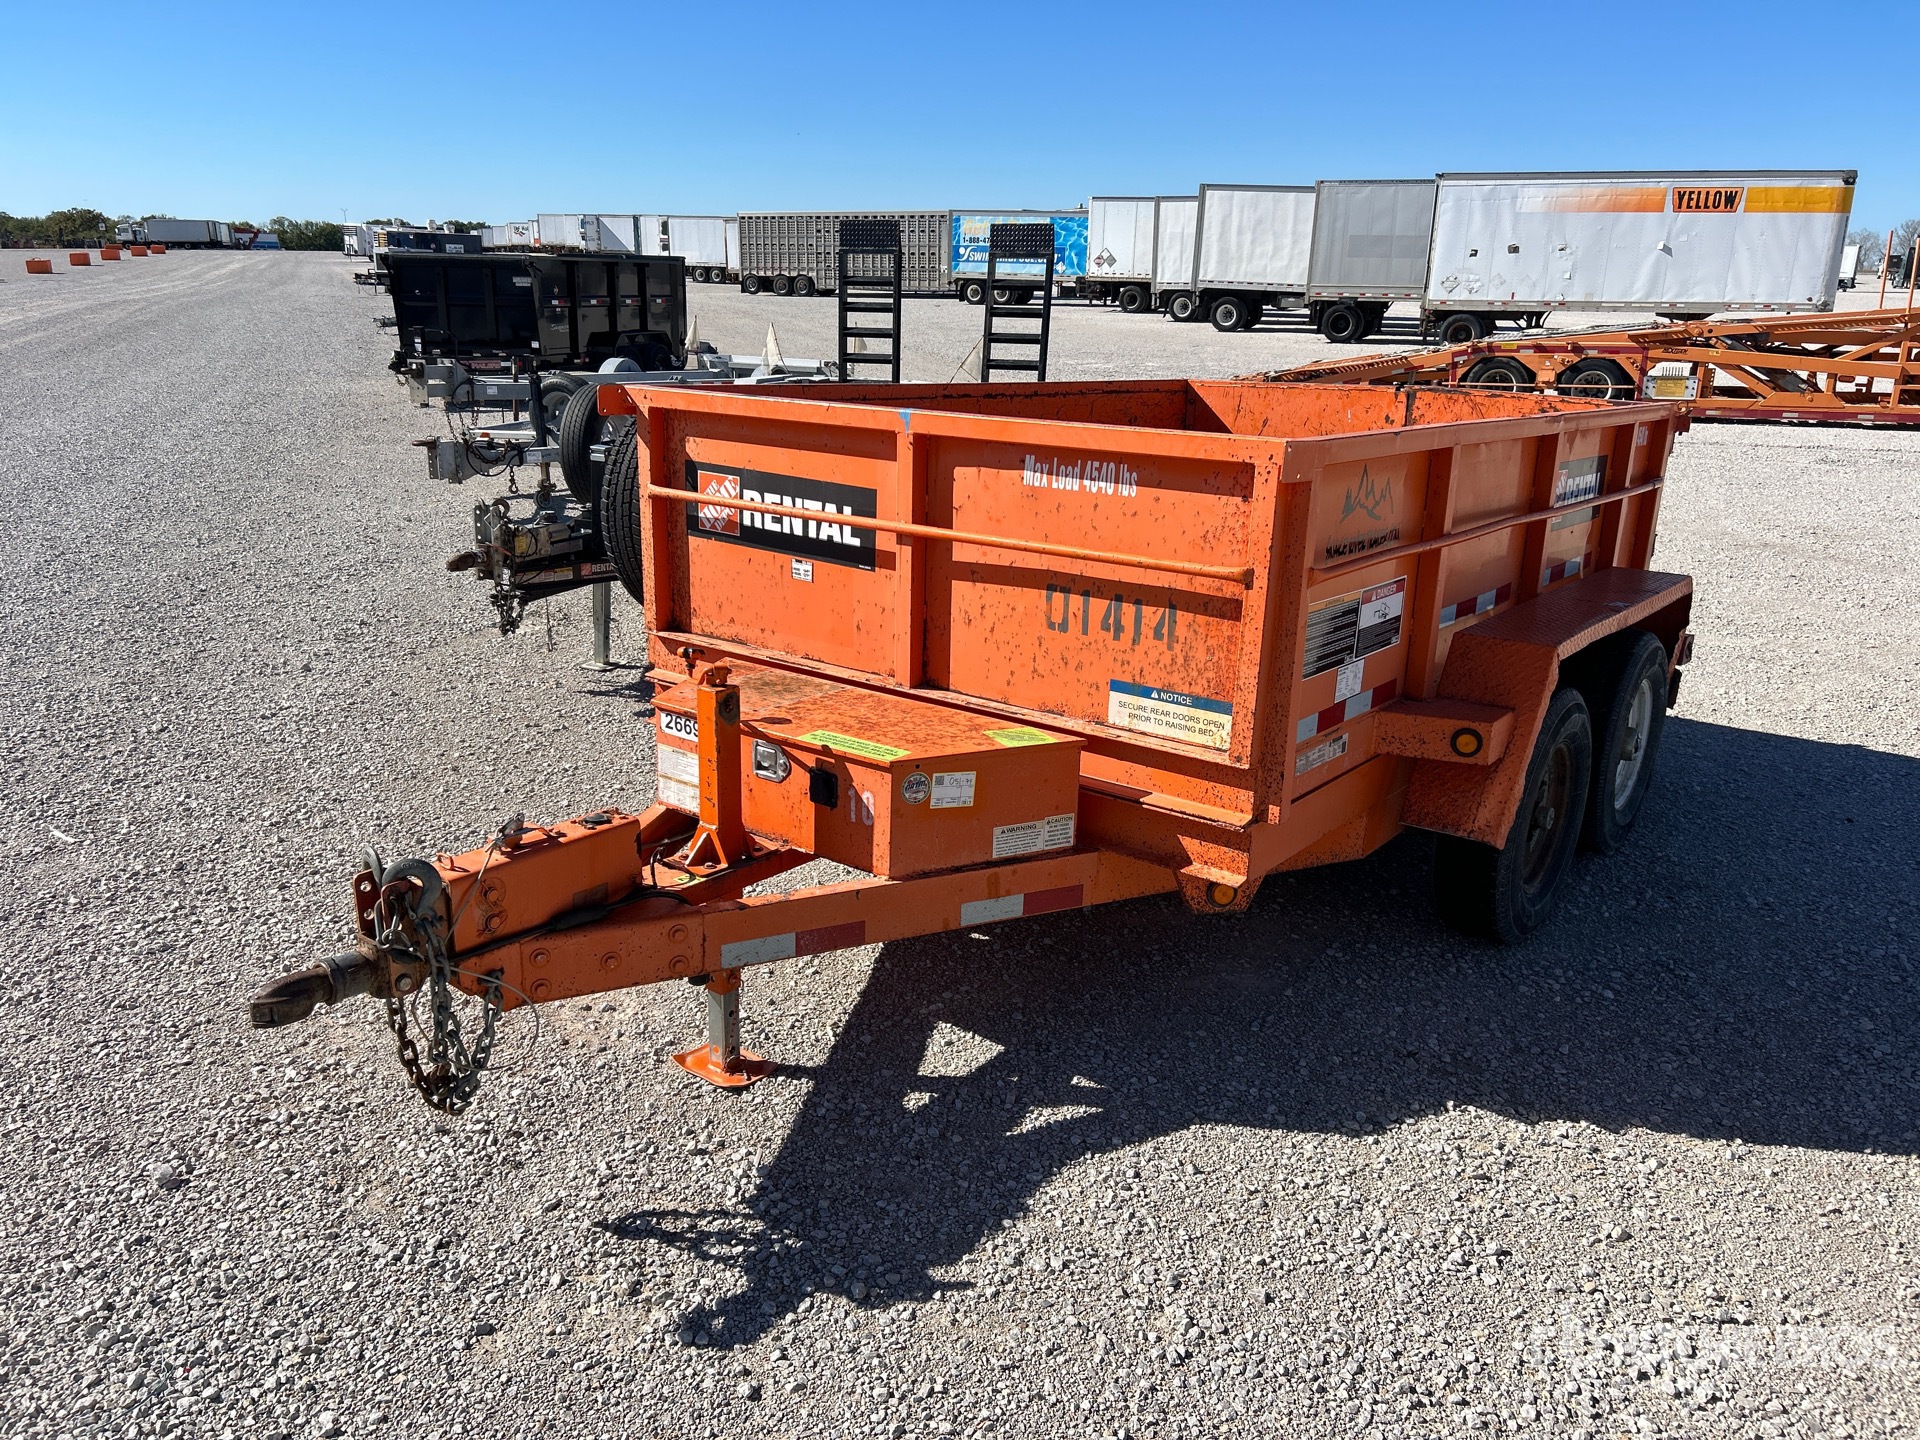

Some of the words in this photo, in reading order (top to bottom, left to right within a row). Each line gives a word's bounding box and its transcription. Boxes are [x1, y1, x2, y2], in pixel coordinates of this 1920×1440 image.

[1677, 190, 1738, 209] YELLOW
[1023, 454, 1048, 488] Max
[1052, 458, 1080, 491] Load
[1083, 461, 1116, 496] 4540
[1118, 465, 1138, 498] lbs
[743, 489, 861, 547] RENTAL
[592, 562, 614, 572] RENTA
[1376, 583, 1397, 599] DANGER
[1045, 584, 1180, 652] 01414
[1160, 692, 1192, 706] NOTICE
[1118, 700, 1148, 714] SECURE
[1150, 707, 1170, 718] REAR
[1172, 710, 1200, 724] DOORS
[1202, 716, 1225, 730] OPEN
[1128, 713, 1152, 724] PRIOR
[1153, 717, 1164, 726] TO
[1166, 720, 1196, 734] RAISING
[1198, 726, 1215, 738] BED
[848, 788, 875, 826] 10
[1006, 824, 1036, 833] WARNING
